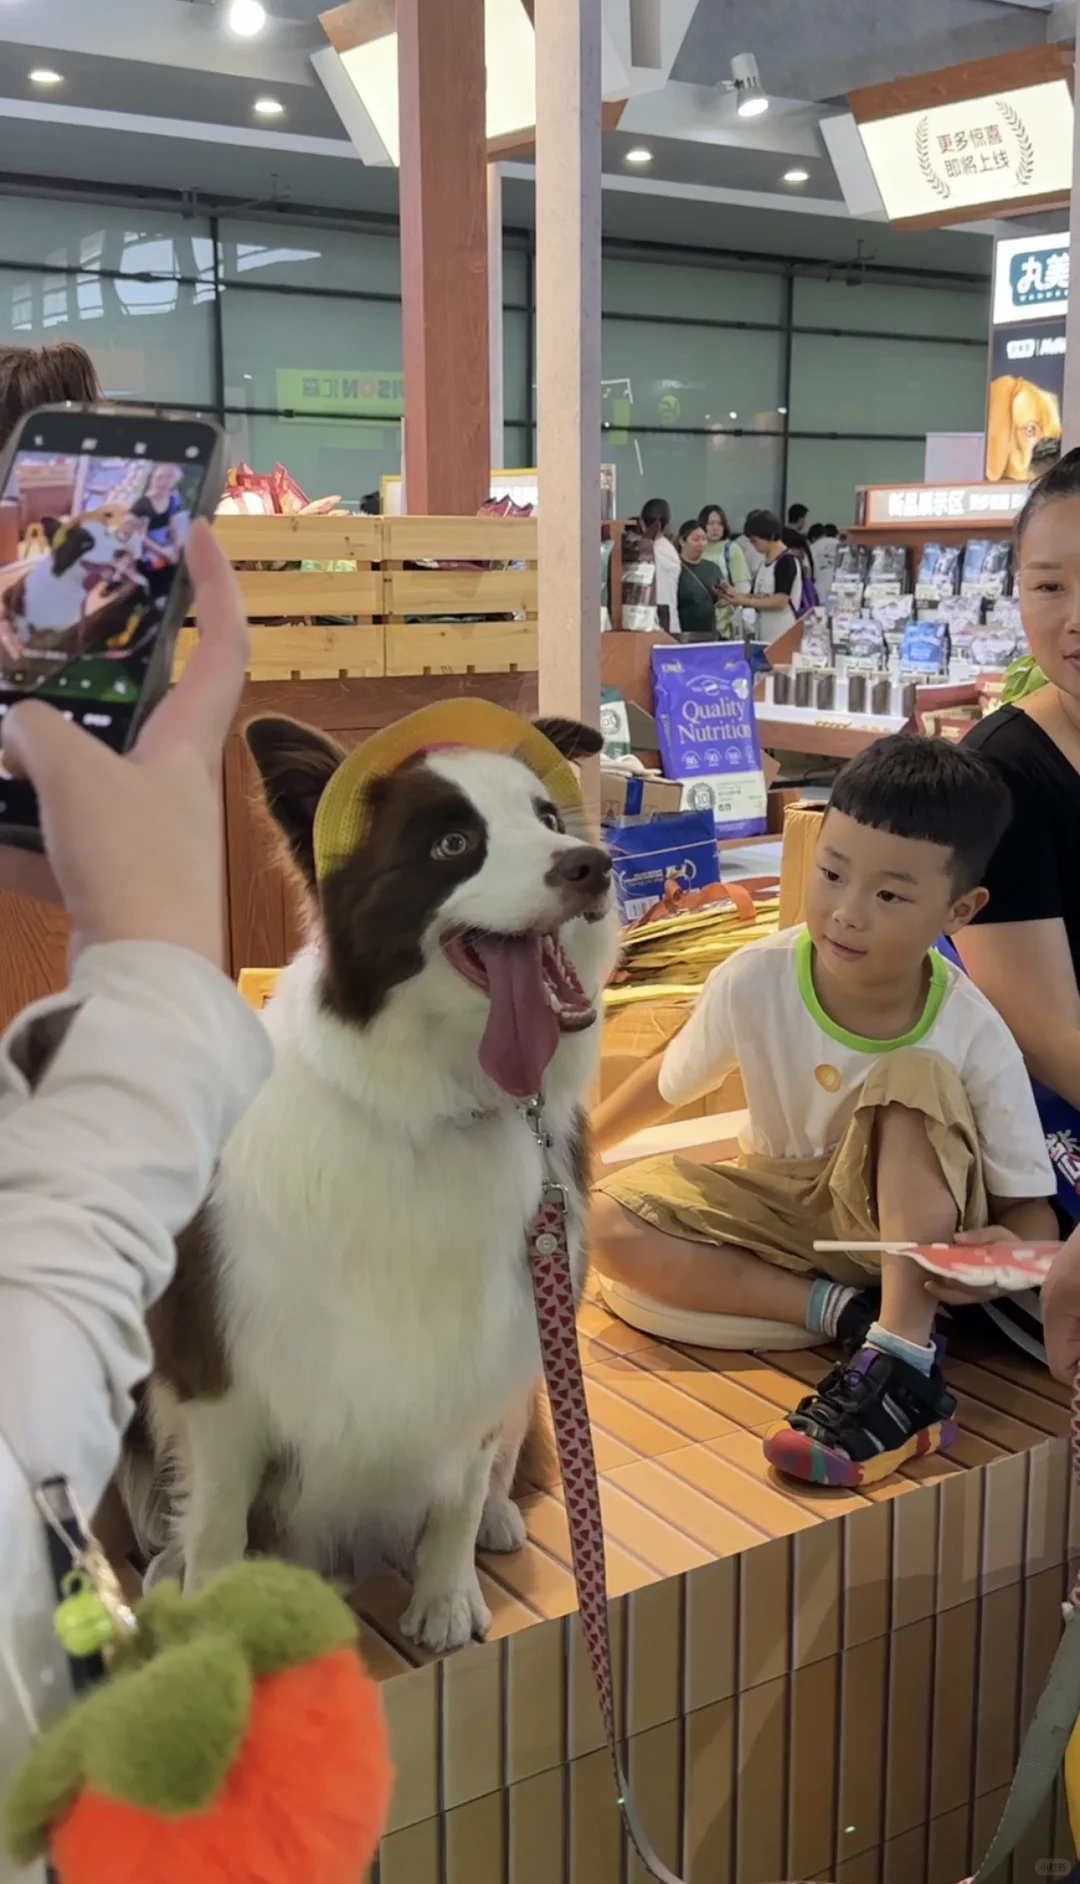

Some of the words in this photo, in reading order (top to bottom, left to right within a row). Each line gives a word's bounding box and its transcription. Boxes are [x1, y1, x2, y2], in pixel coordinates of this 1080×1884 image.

[936, 124, 1003, 154] 更多惊喜
[944, 149, 1010, 178] 即将上线
[681, 697, 745, 724] Quality
[677, 720, 752, 745] Nutrition
